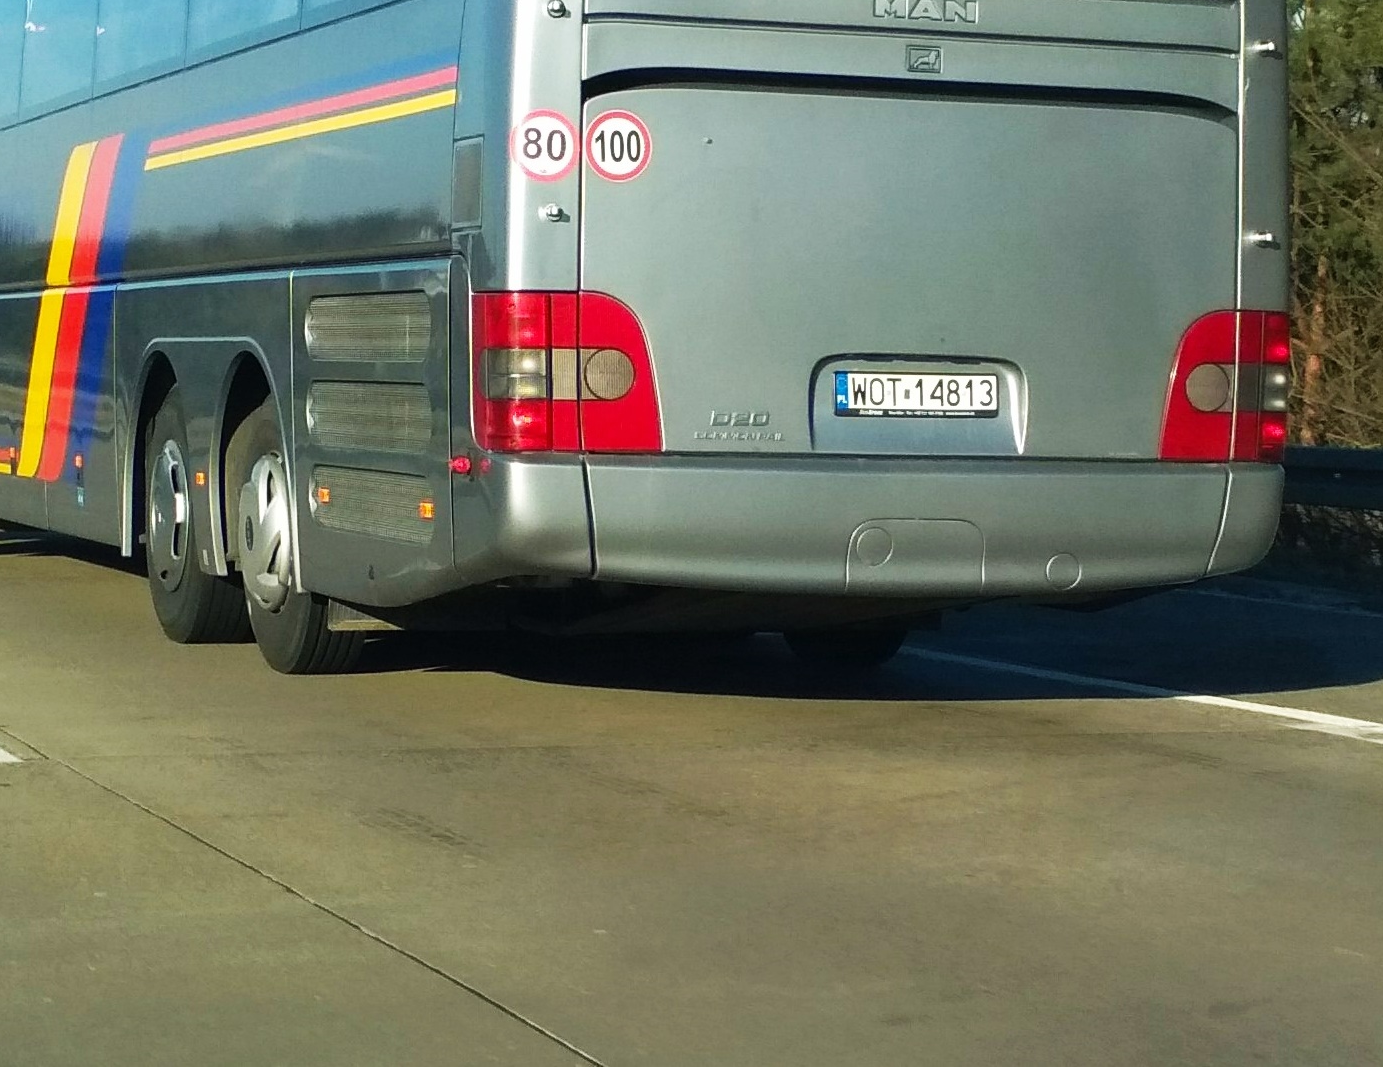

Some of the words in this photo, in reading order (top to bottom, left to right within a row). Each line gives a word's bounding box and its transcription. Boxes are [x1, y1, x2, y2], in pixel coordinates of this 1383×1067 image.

[522, 127, 567, 161] 80
[594, 130, 641, 163] 100
[852, 377, 902, 407] WOT
[915, 378, 993, 407] 14813
[709, 410, 770, 427] D20
